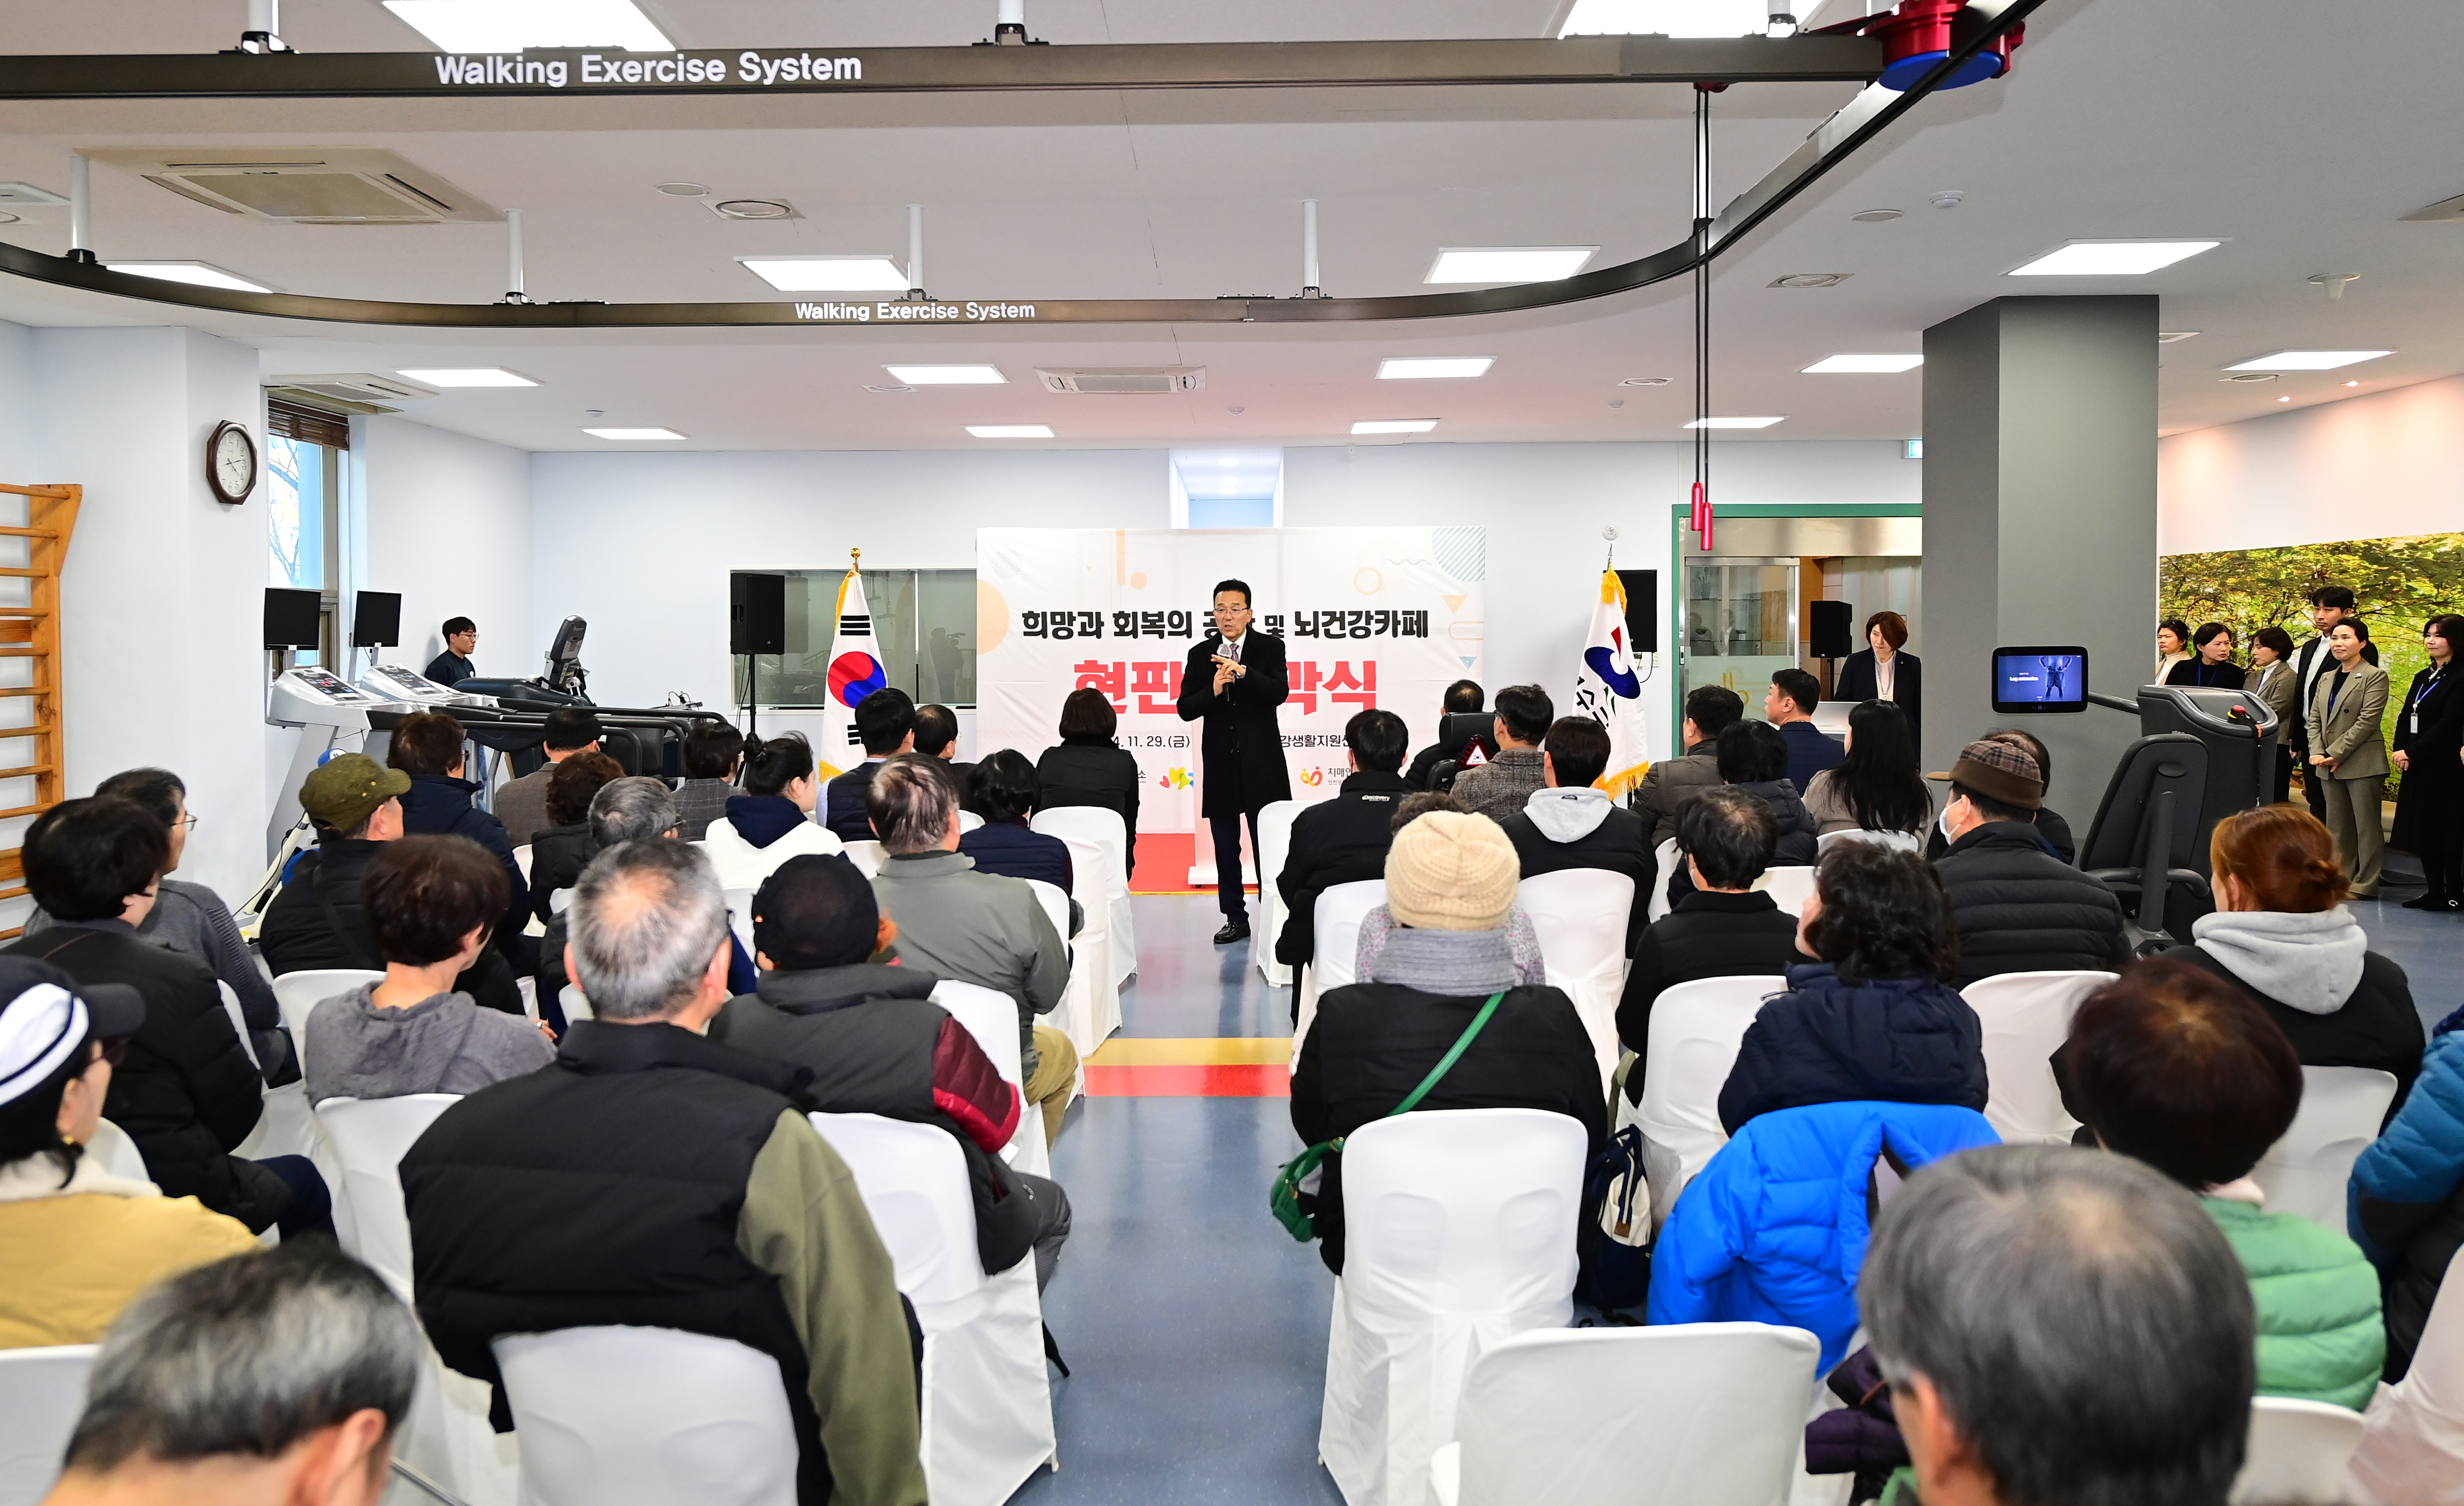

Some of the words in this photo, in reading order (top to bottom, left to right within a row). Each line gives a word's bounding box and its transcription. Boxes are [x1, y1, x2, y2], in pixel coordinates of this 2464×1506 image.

[435, 55, 568, 88] Walking
[581, 53, 727, 83] Exercise
[738, 51, 862, 85] System
[795, 303, 870, 321] Walking
[877, 302, 959, 319] Exercise
[965, 302, 1035, 321] System
[1022, 610, 1104, 639] 희망과
[1113, 610, 1193, 639] 회복의
[1294, 610, 1428, 639] 뇌건강카페
[1074, 660, 1185, 714] 현판
[1285, 661, 1377, 716] 막식
[1128, 736, 1143, 747] 11.
[1147, 735, 1190, 748] 29.(금)
